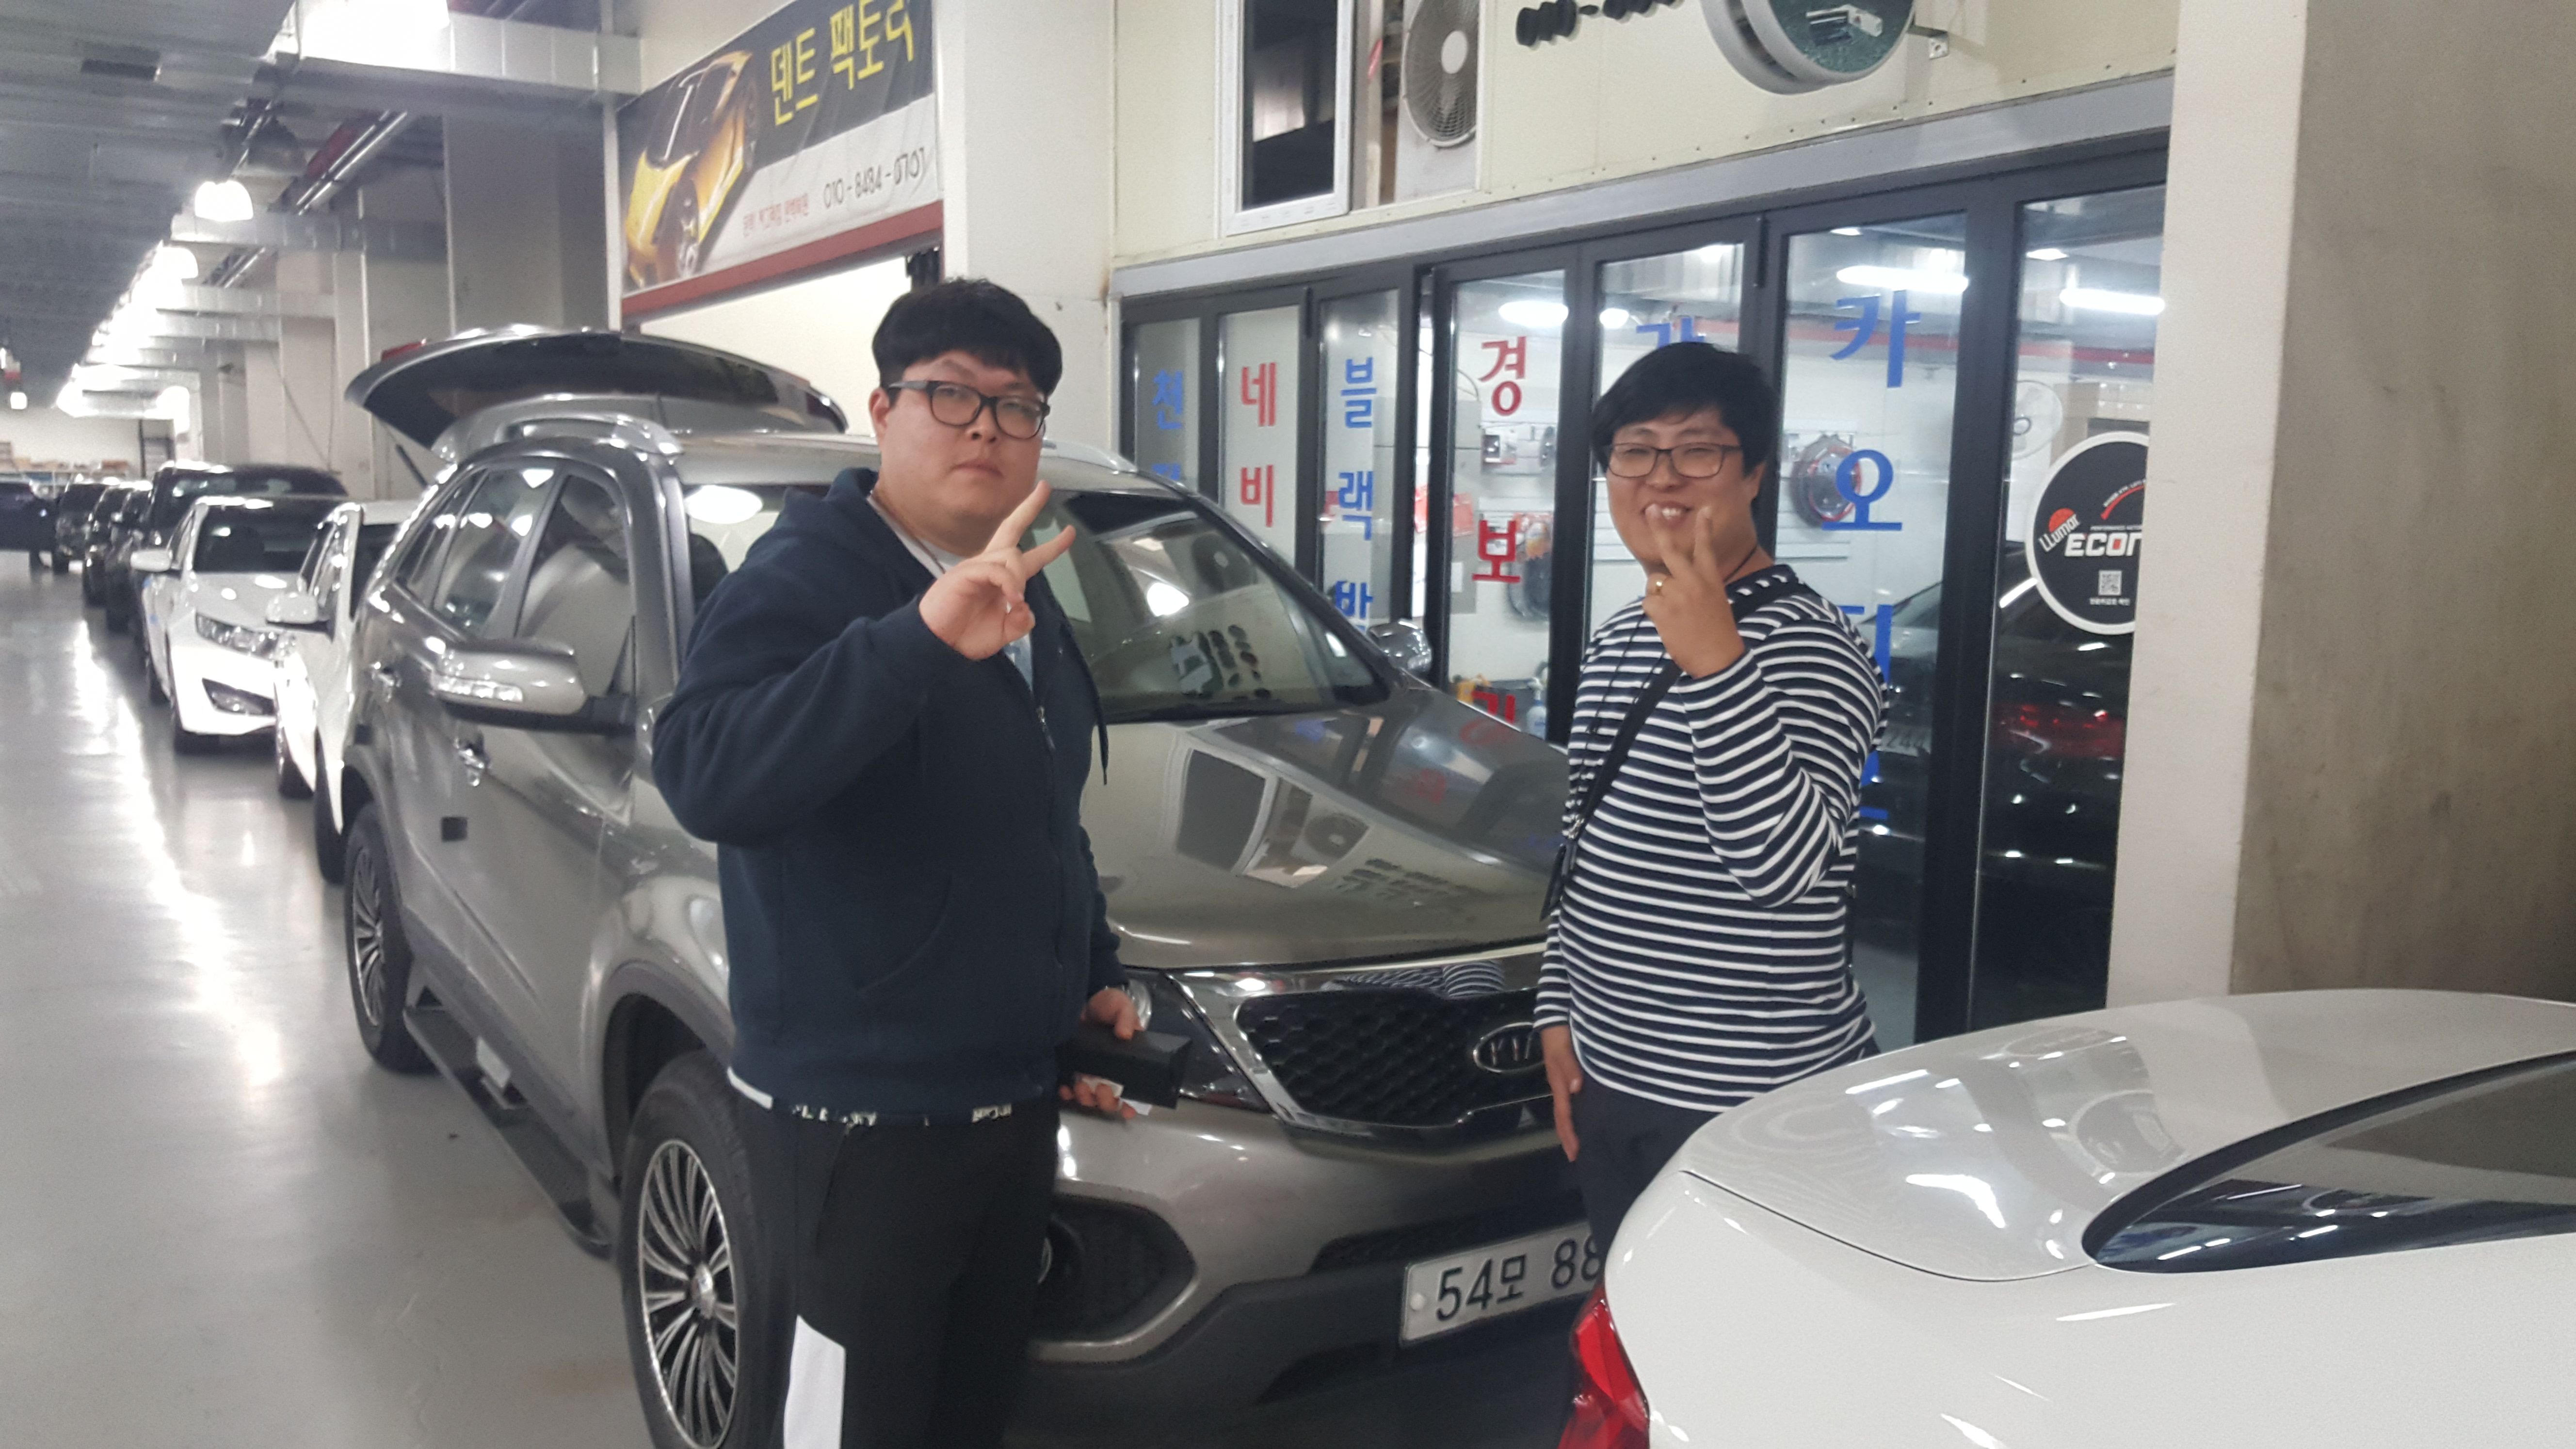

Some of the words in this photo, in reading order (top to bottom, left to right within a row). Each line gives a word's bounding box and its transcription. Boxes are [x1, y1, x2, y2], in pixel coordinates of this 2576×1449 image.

[771, 28, 819, 126] 덴트
[1240, 362, 1277, 528] 네비
[1437, 1254, 1527, 1321] 54모
